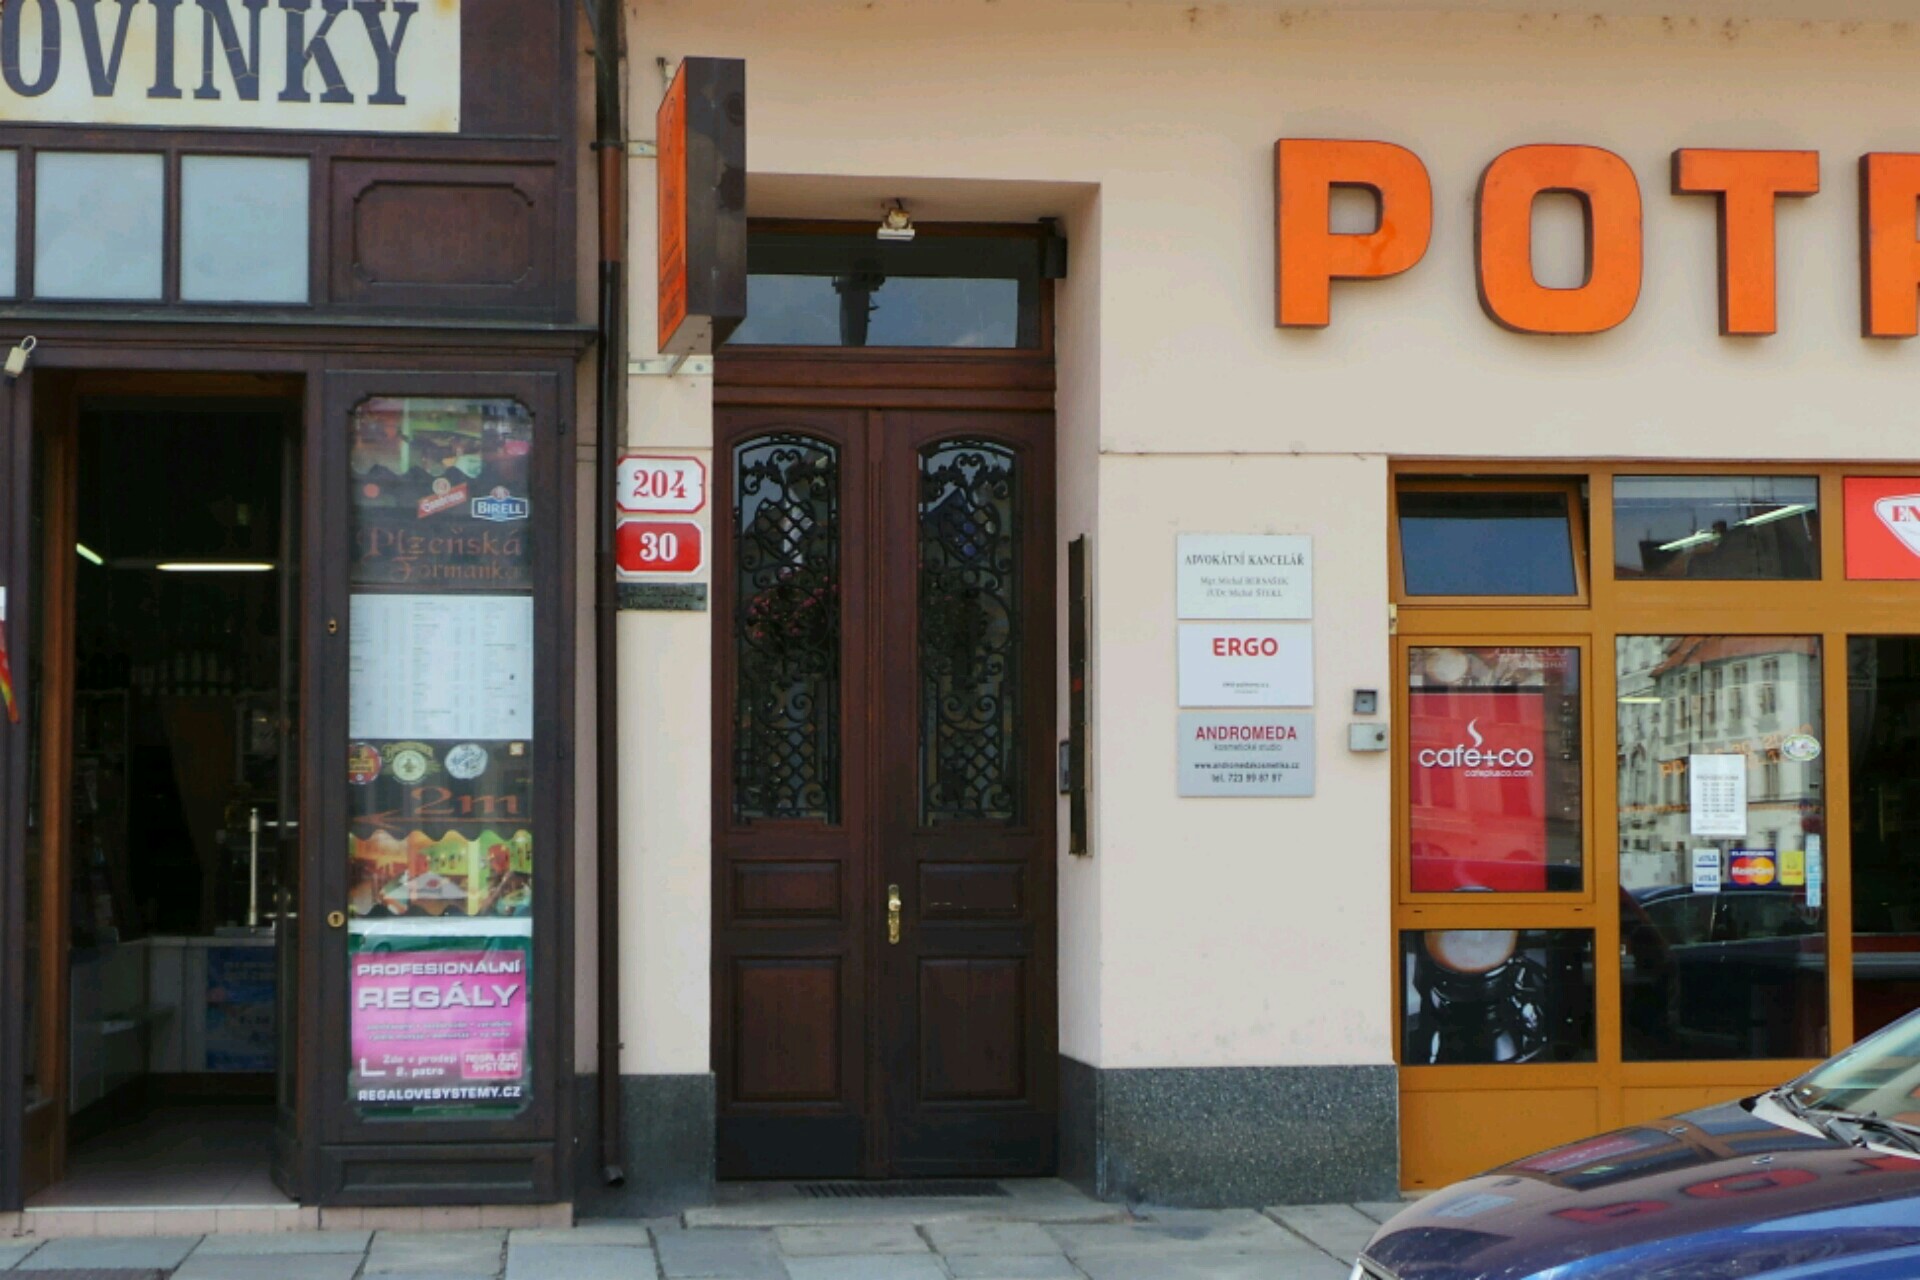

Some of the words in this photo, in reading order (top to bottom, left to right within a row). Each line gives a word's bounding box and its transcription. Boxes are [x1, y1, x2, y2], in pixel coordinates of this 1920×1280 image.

[1, 0, 419, 105] OVINKY
[632, 469, 687, 498] 204
[477, 501, 524, 515] BIRELL
[640, 531, 678, 562] 30
[1185, 549, 1246, 565] ADVOKÁTNÍ
[1247, 551, 1304, 565] KANCELÁŘ
[1212, 637, 1279, 657] ERGO
[1195, 726, 1297, 740] ANDROMEDA
[357, 960, 521, 976] PROFESIONÁLNÍ
[358, 981, 519, 1009] REGÁLY
[358, 1086, 522, 1101] REGALOVESYSTEMY.CZ
